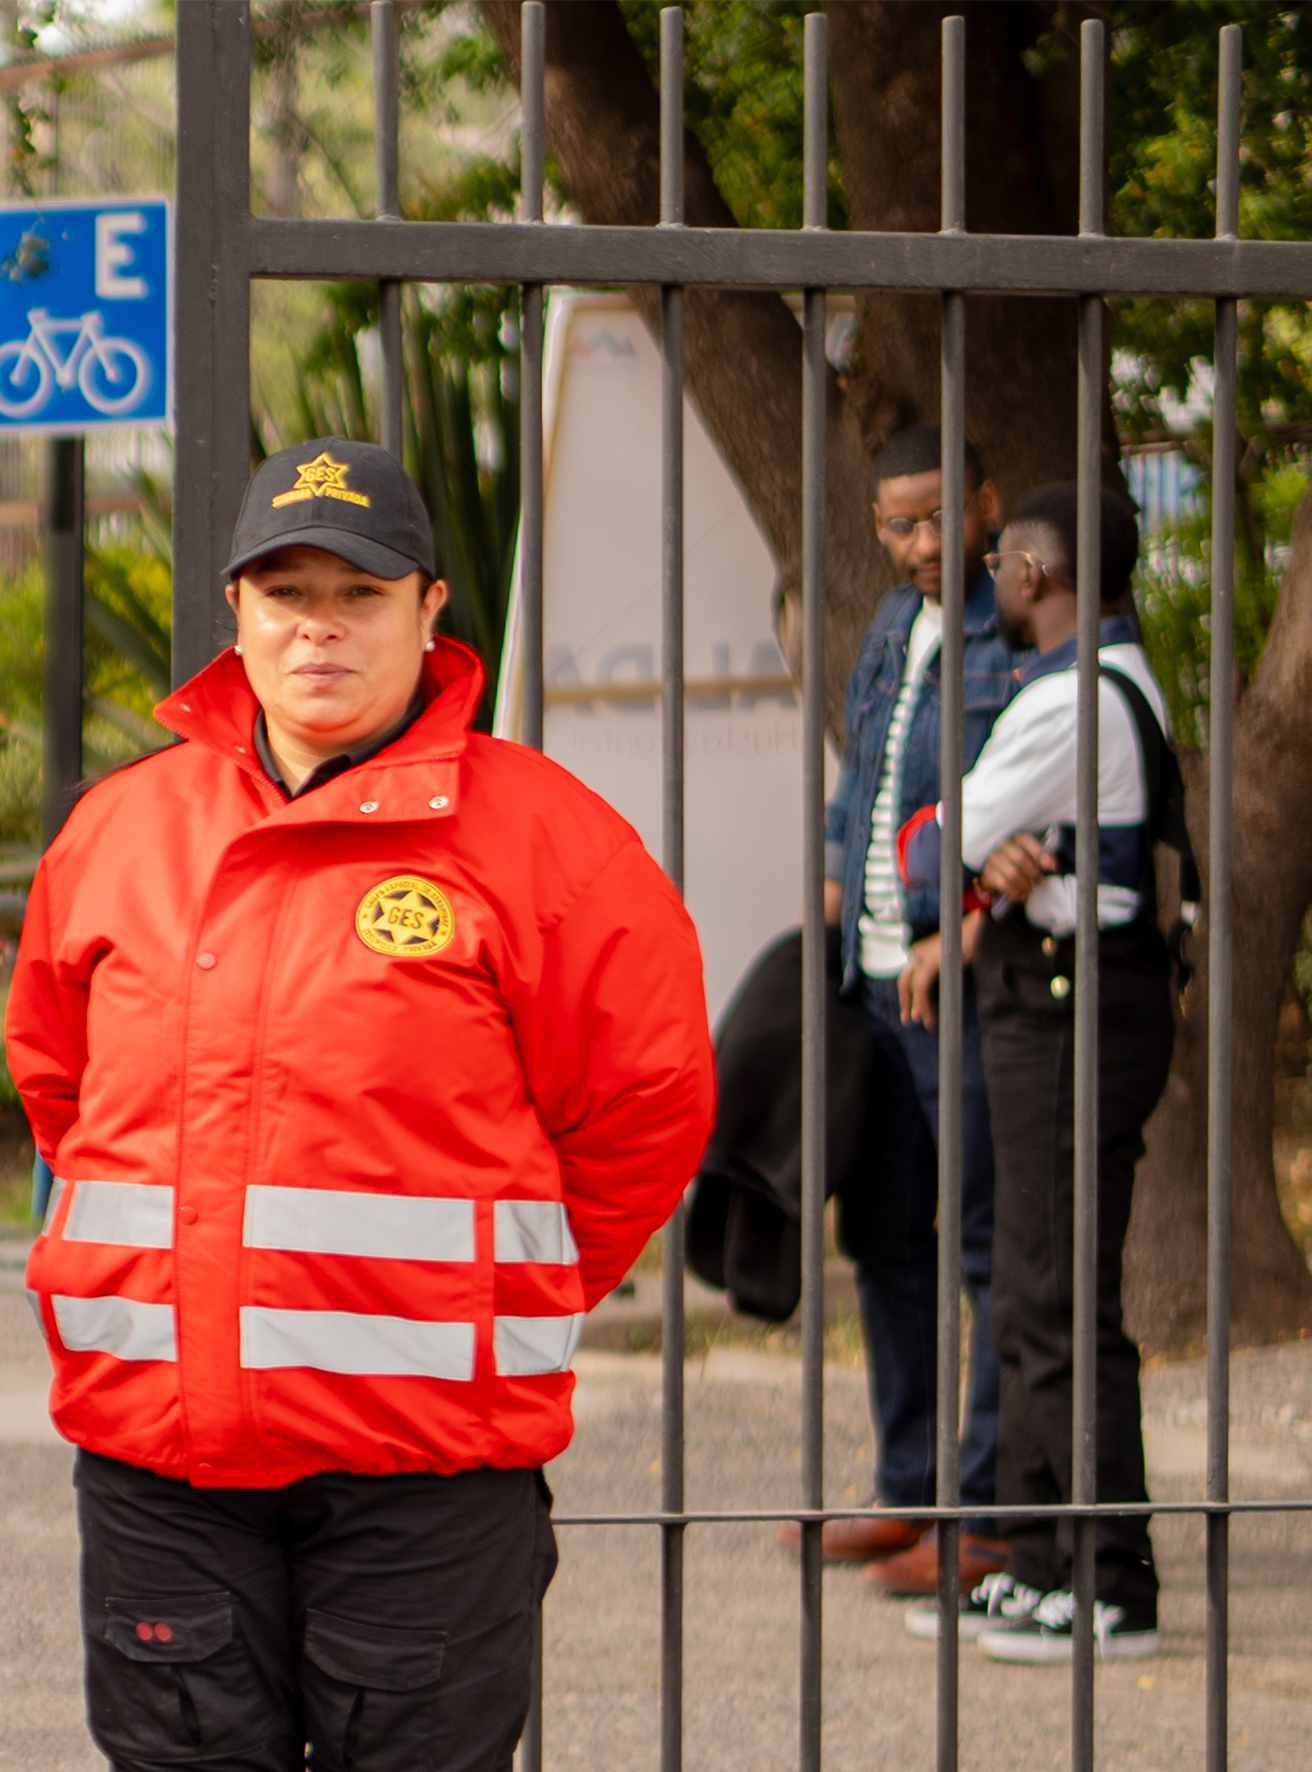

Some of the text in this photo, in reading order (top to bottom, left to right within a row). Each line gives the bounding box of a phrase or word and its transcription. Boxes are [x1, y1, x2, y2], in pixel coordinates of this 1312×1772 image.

[95, 212, 148, 299] E
[305, 466, 336, 482] GES
[387, 906, 424, 930] GES
